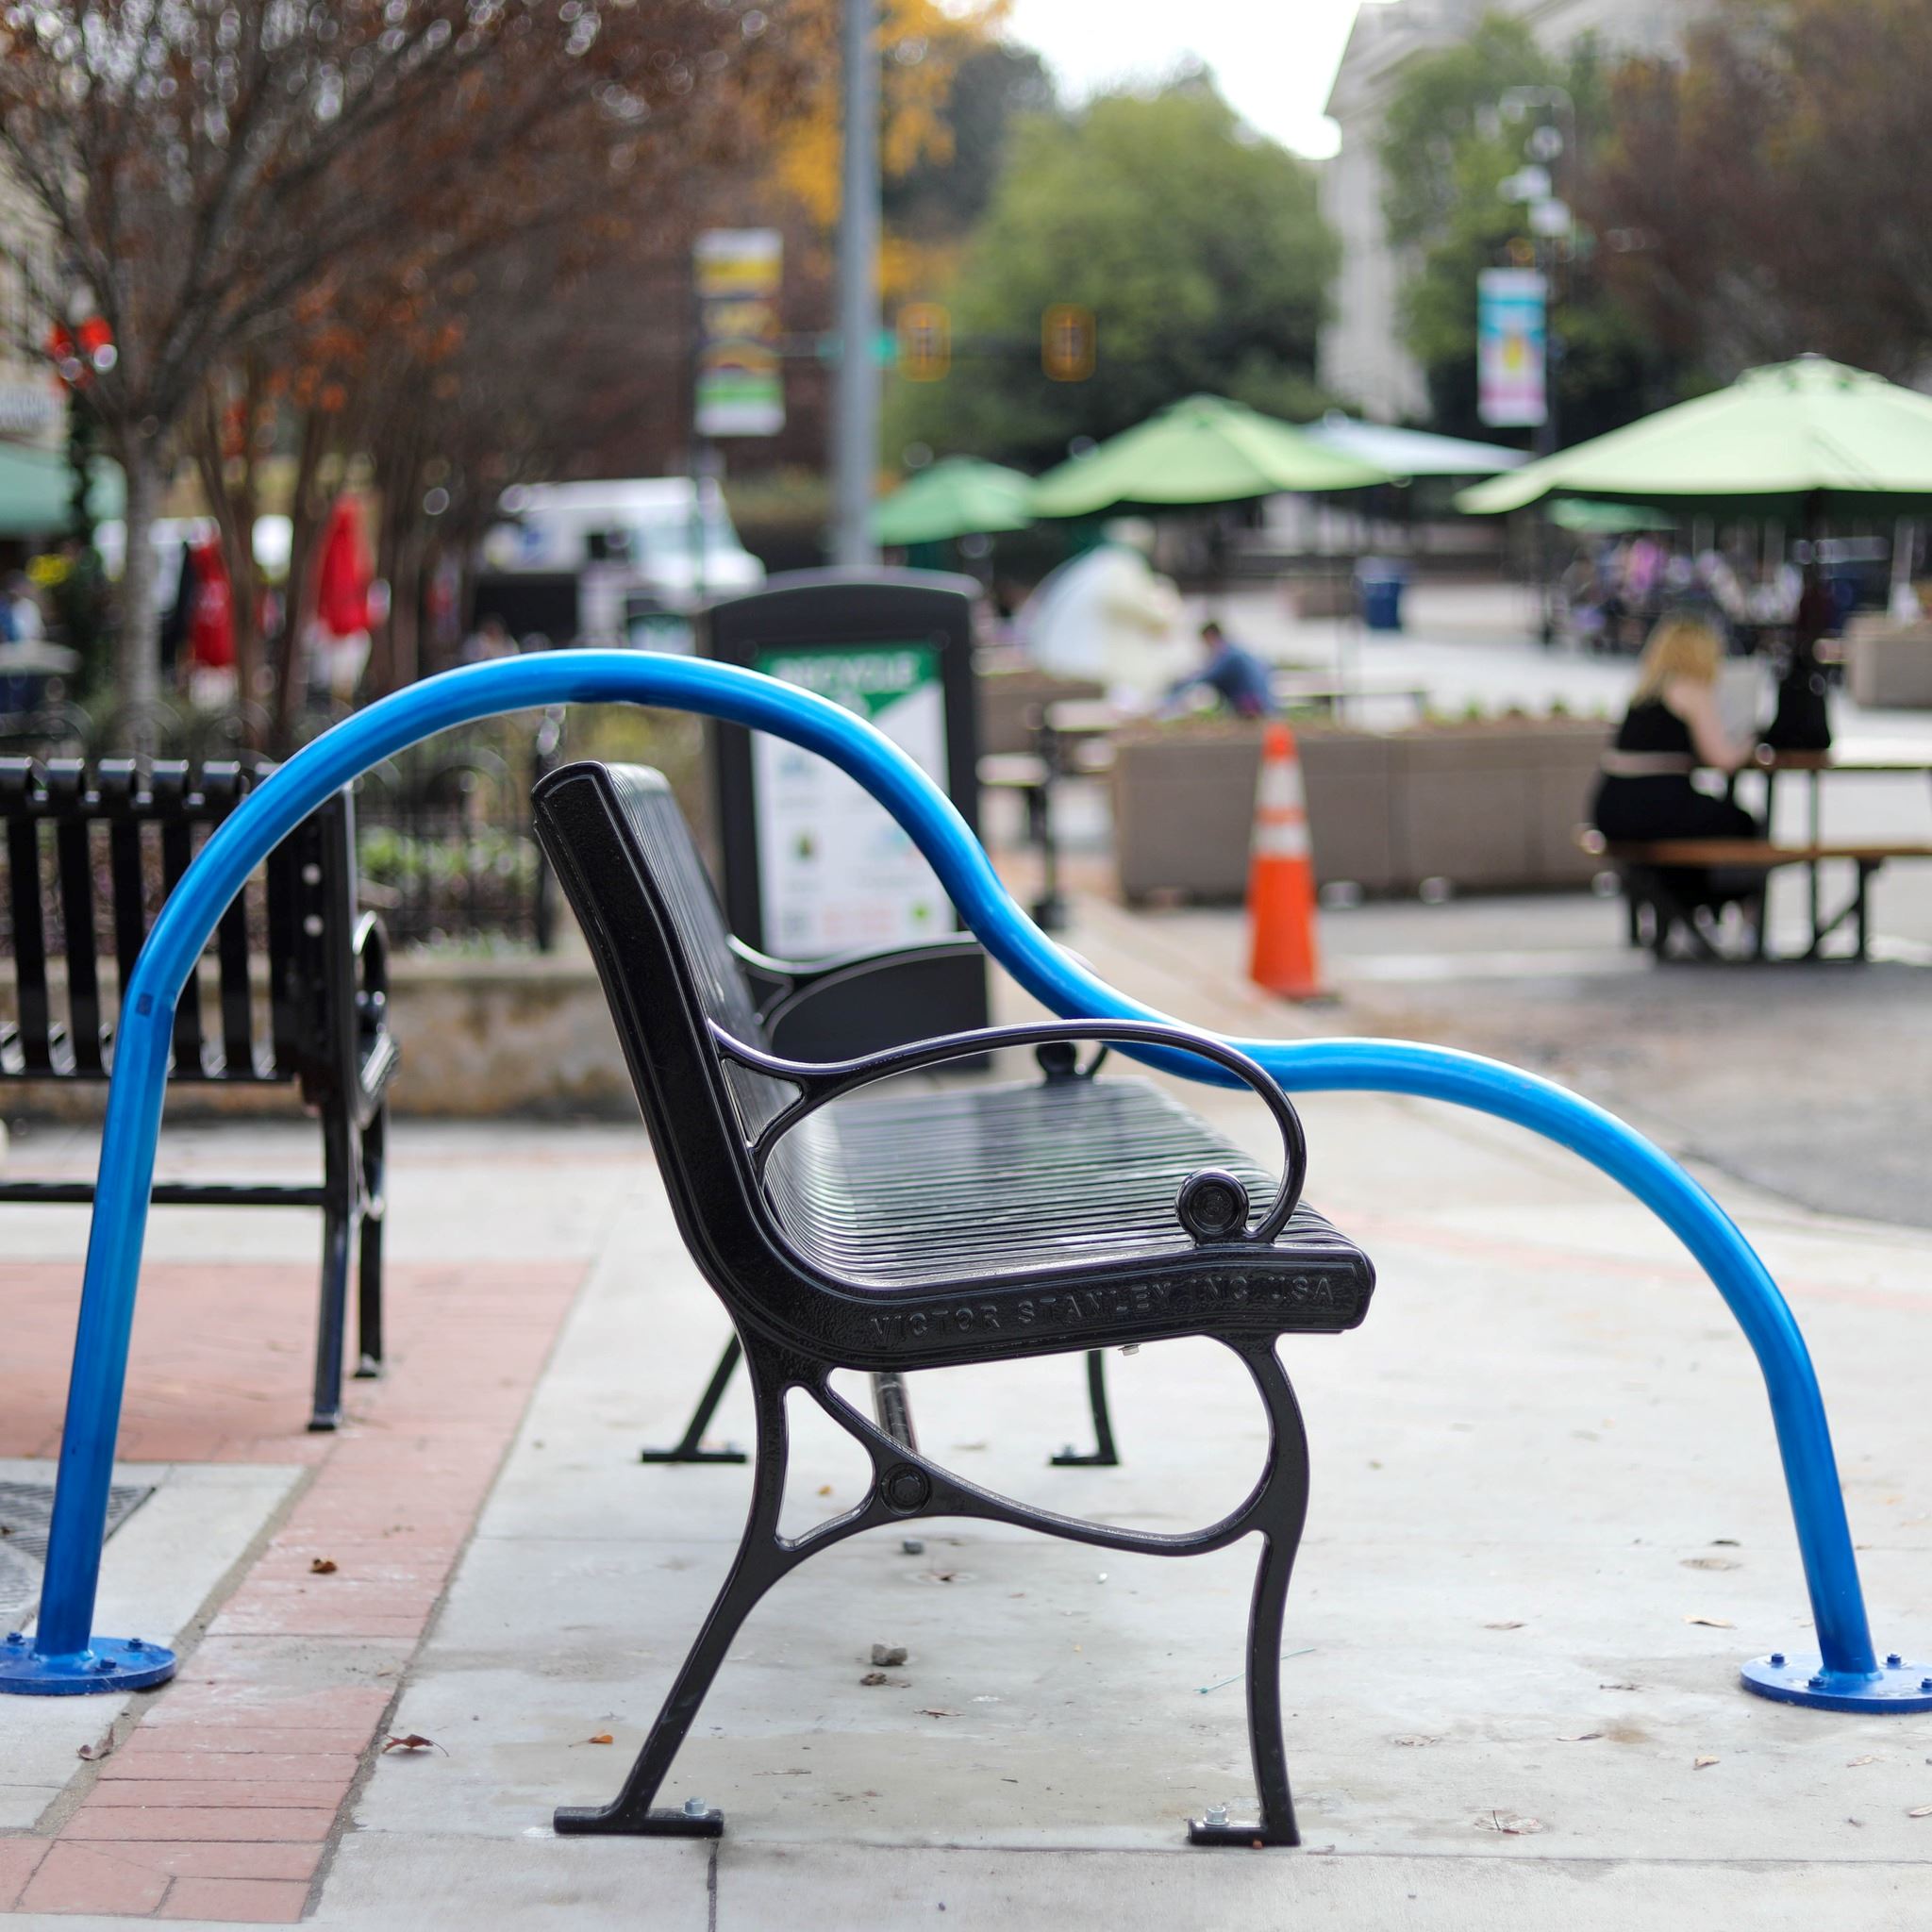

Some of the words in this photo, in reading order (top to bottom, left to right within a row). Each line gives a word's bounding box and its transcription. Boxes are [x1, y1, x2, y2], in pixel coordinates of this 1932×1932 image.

[870, 1305, 1000, 1337] VICTOR
[1017, 1282, 1172, 1324] STANLEY
[1267, 1274, 1334, 1301] USA
